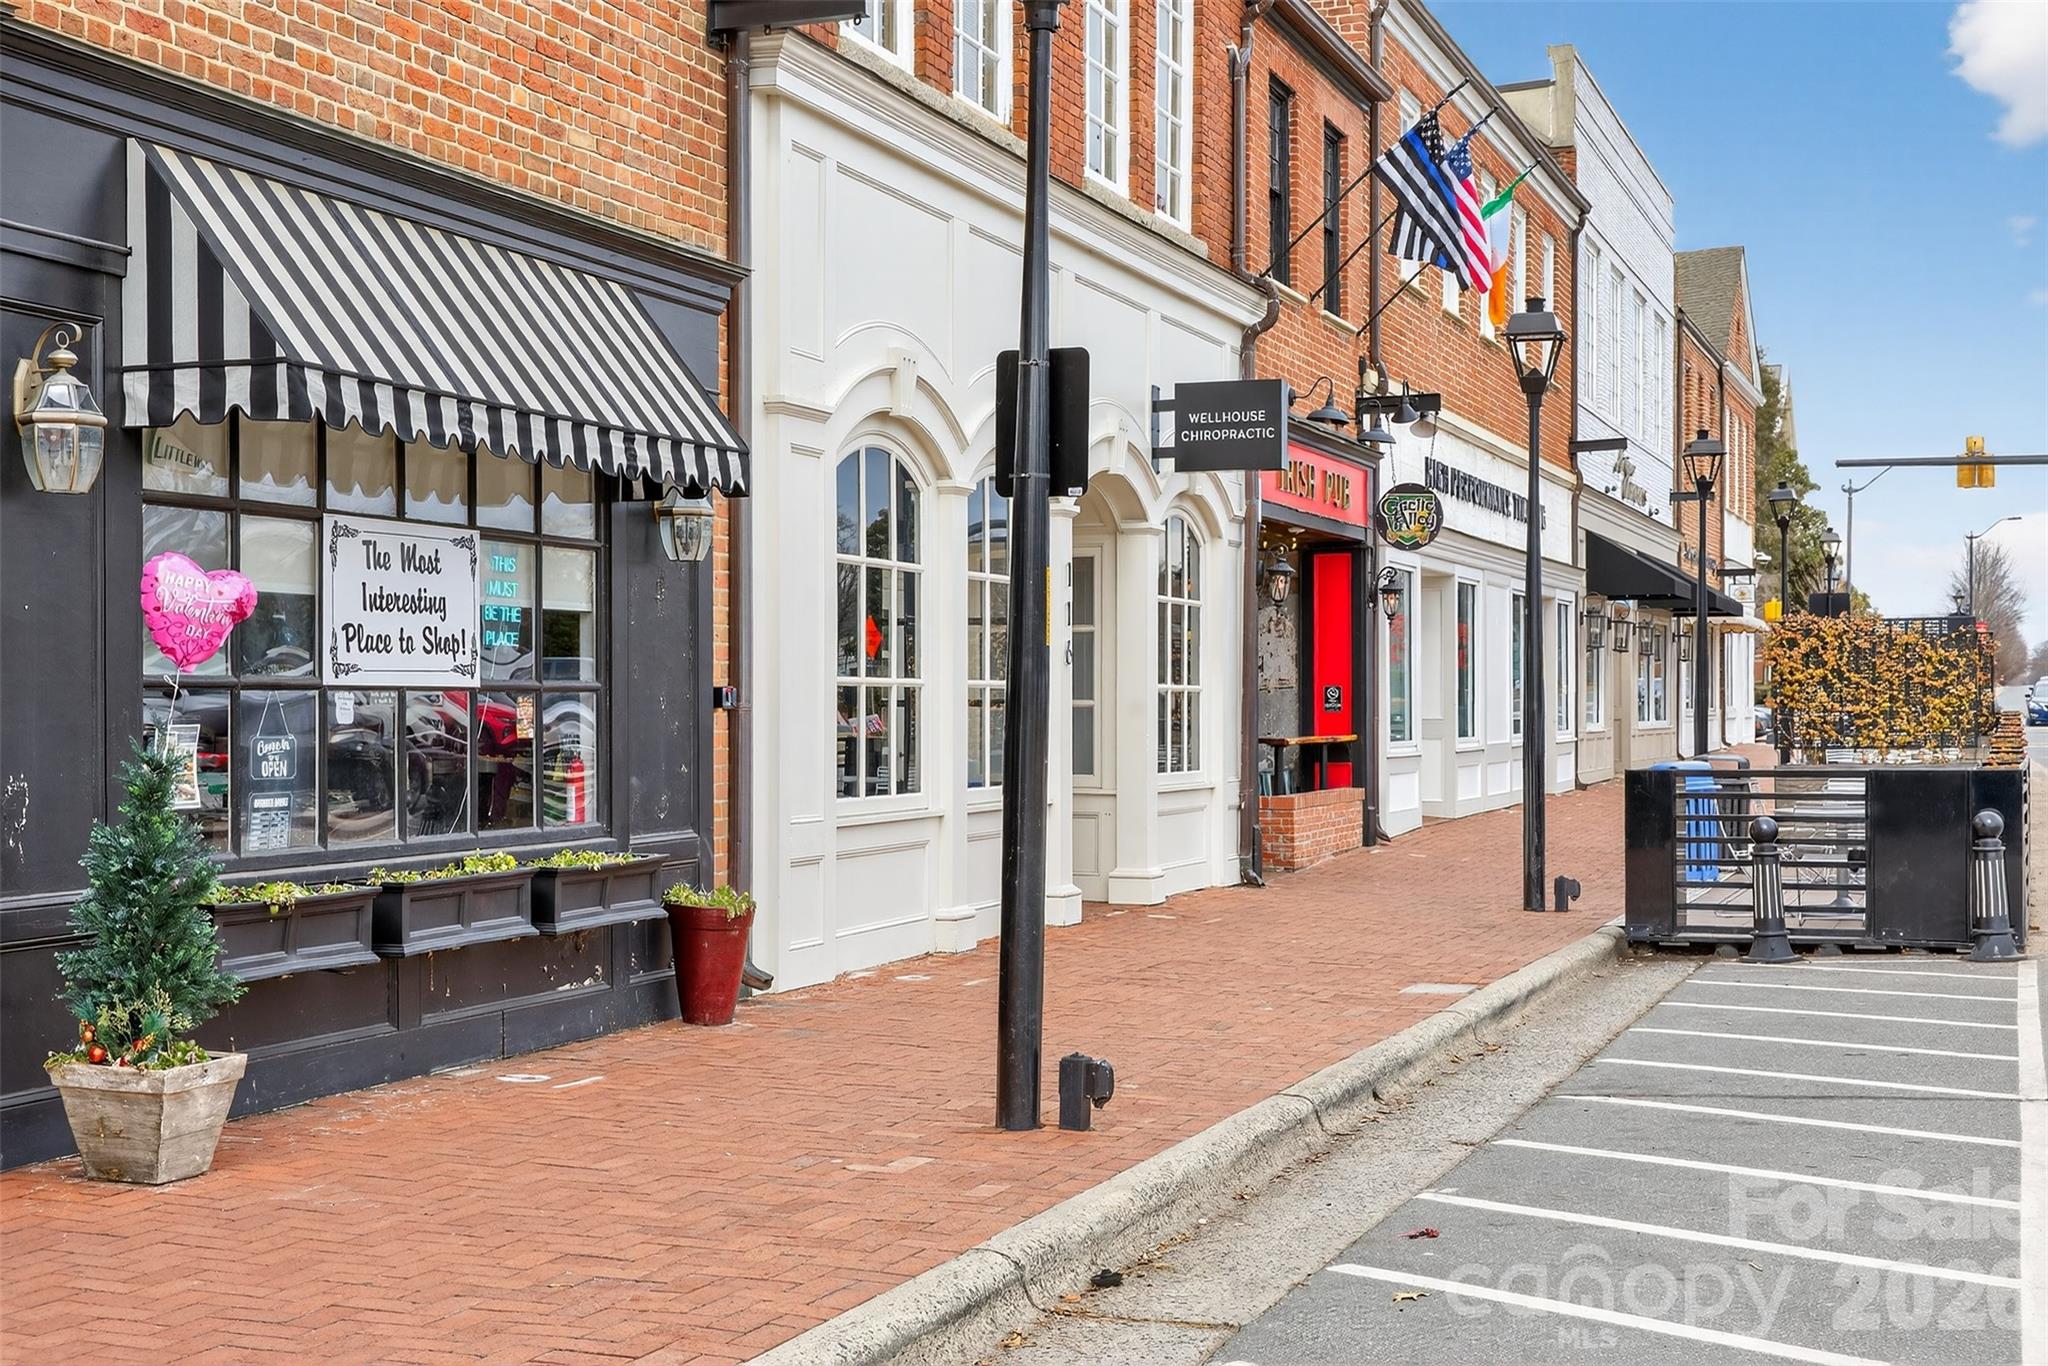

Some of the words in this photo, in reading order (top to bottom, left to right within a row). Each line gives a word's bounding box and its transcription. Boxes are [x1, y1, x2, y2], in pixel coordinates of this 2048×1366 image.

[1188, 410, 1266, 423] WELLHOUSE
[1181, 426, 1275, 441] CHIROPRACTIC
[1322, 470, 1351, 511] PUB
[361, 539, 392, 572] The
[400, 541, 442, 576] Most
[490, 555, 517, 573] THIS
[165, 570, 213, 594] HAPPY
[486, 580, 519, 598] MUST
[361, 582, 446, 623] Interesting
[484, 605, 499, 621] BE
[500, 606, 522, 623] THE
[186, 624, 211, 640] DAY
[485, 630, 520, 647] PLACE
[341, 623, 394, 654] Place
[399, 626, 416, 655] to
[422, 625, 467, 663] Shop!
[261, 760, 288, 778] OPEN
